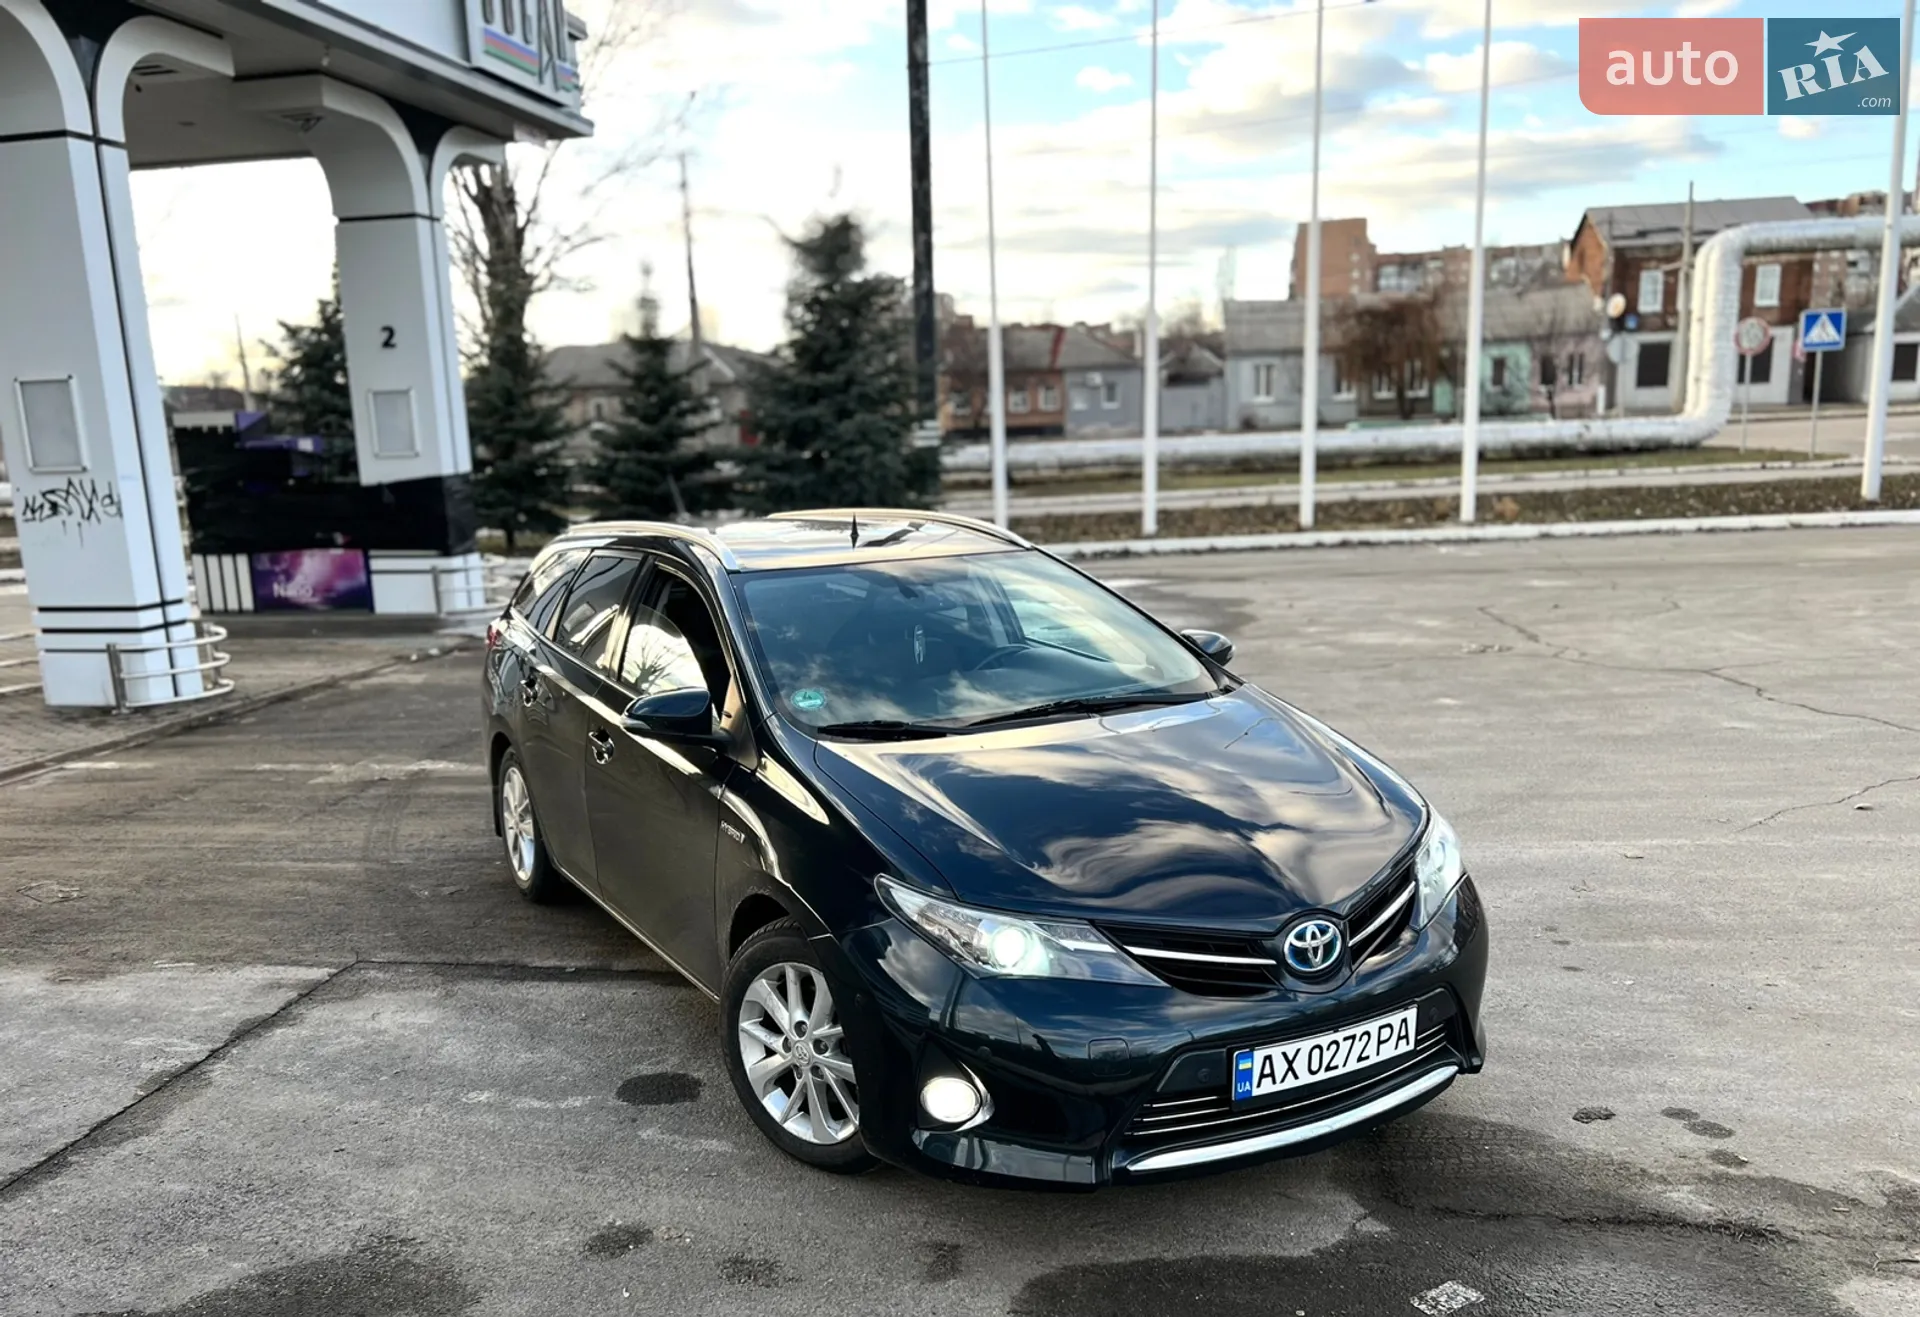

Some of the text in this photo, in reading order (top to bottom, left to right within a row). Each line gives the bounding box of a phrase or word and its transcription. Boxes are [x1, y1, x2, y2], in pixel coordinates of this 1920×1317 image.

[380, 325, 396, 349] 2
[1256, 1047, 1302, 1088] AX
[1307, 1030, 1371, 1076] 0272
[1237, 1082, 1251, 1093] UA
